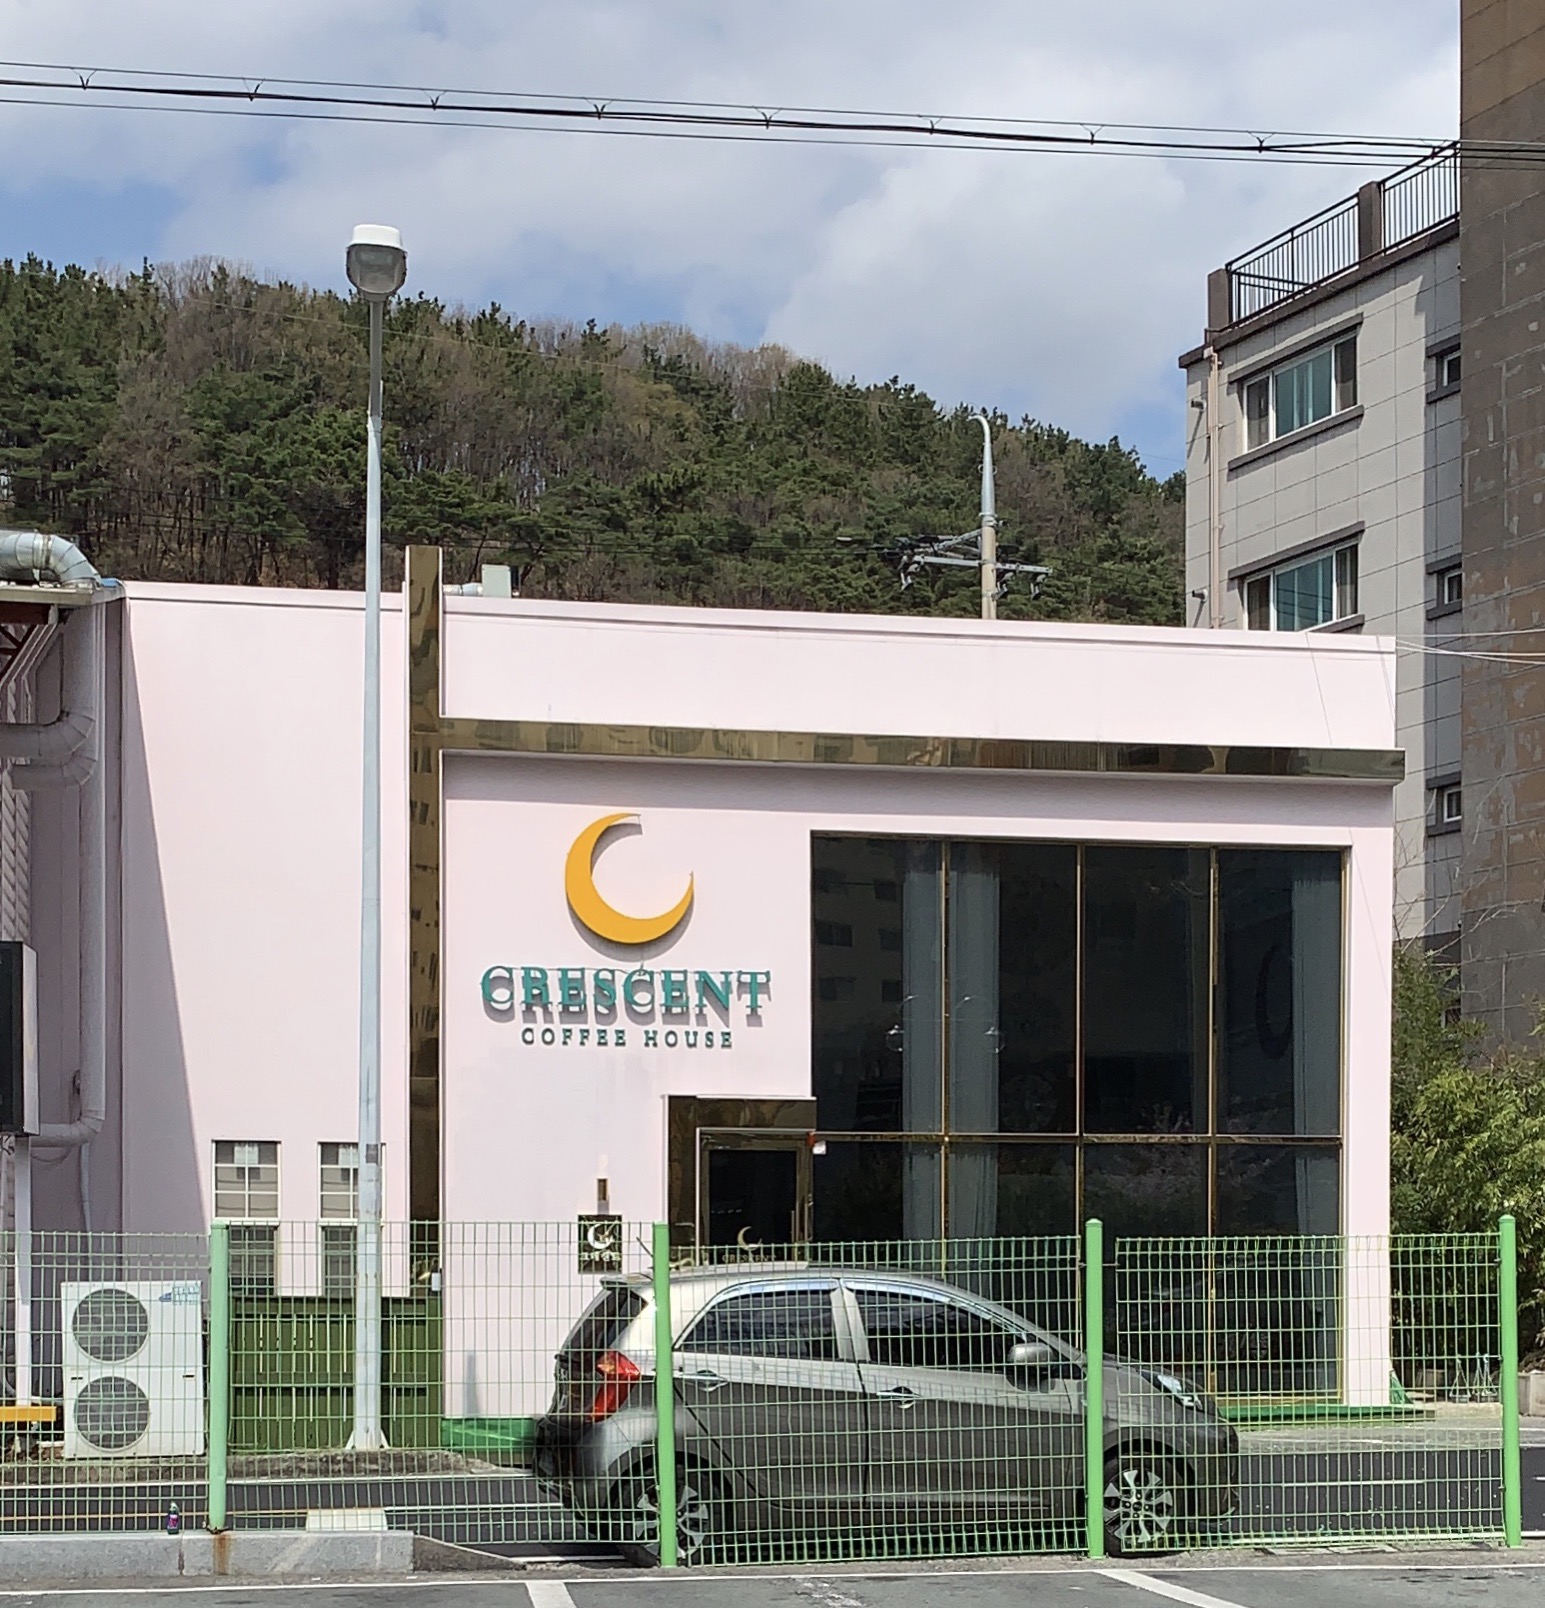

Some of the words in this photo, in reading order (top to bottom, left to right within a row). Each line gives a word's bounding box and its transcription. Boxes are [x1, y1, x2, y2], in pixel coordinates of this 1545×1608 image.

[481, 965, 771, 1009] CRESCENT
[521, 1028, 626, 1046] COFFEE
[644, 1030, 732, 1049] HOUSE
[721, 1254, 777, 1263] CRESEN
